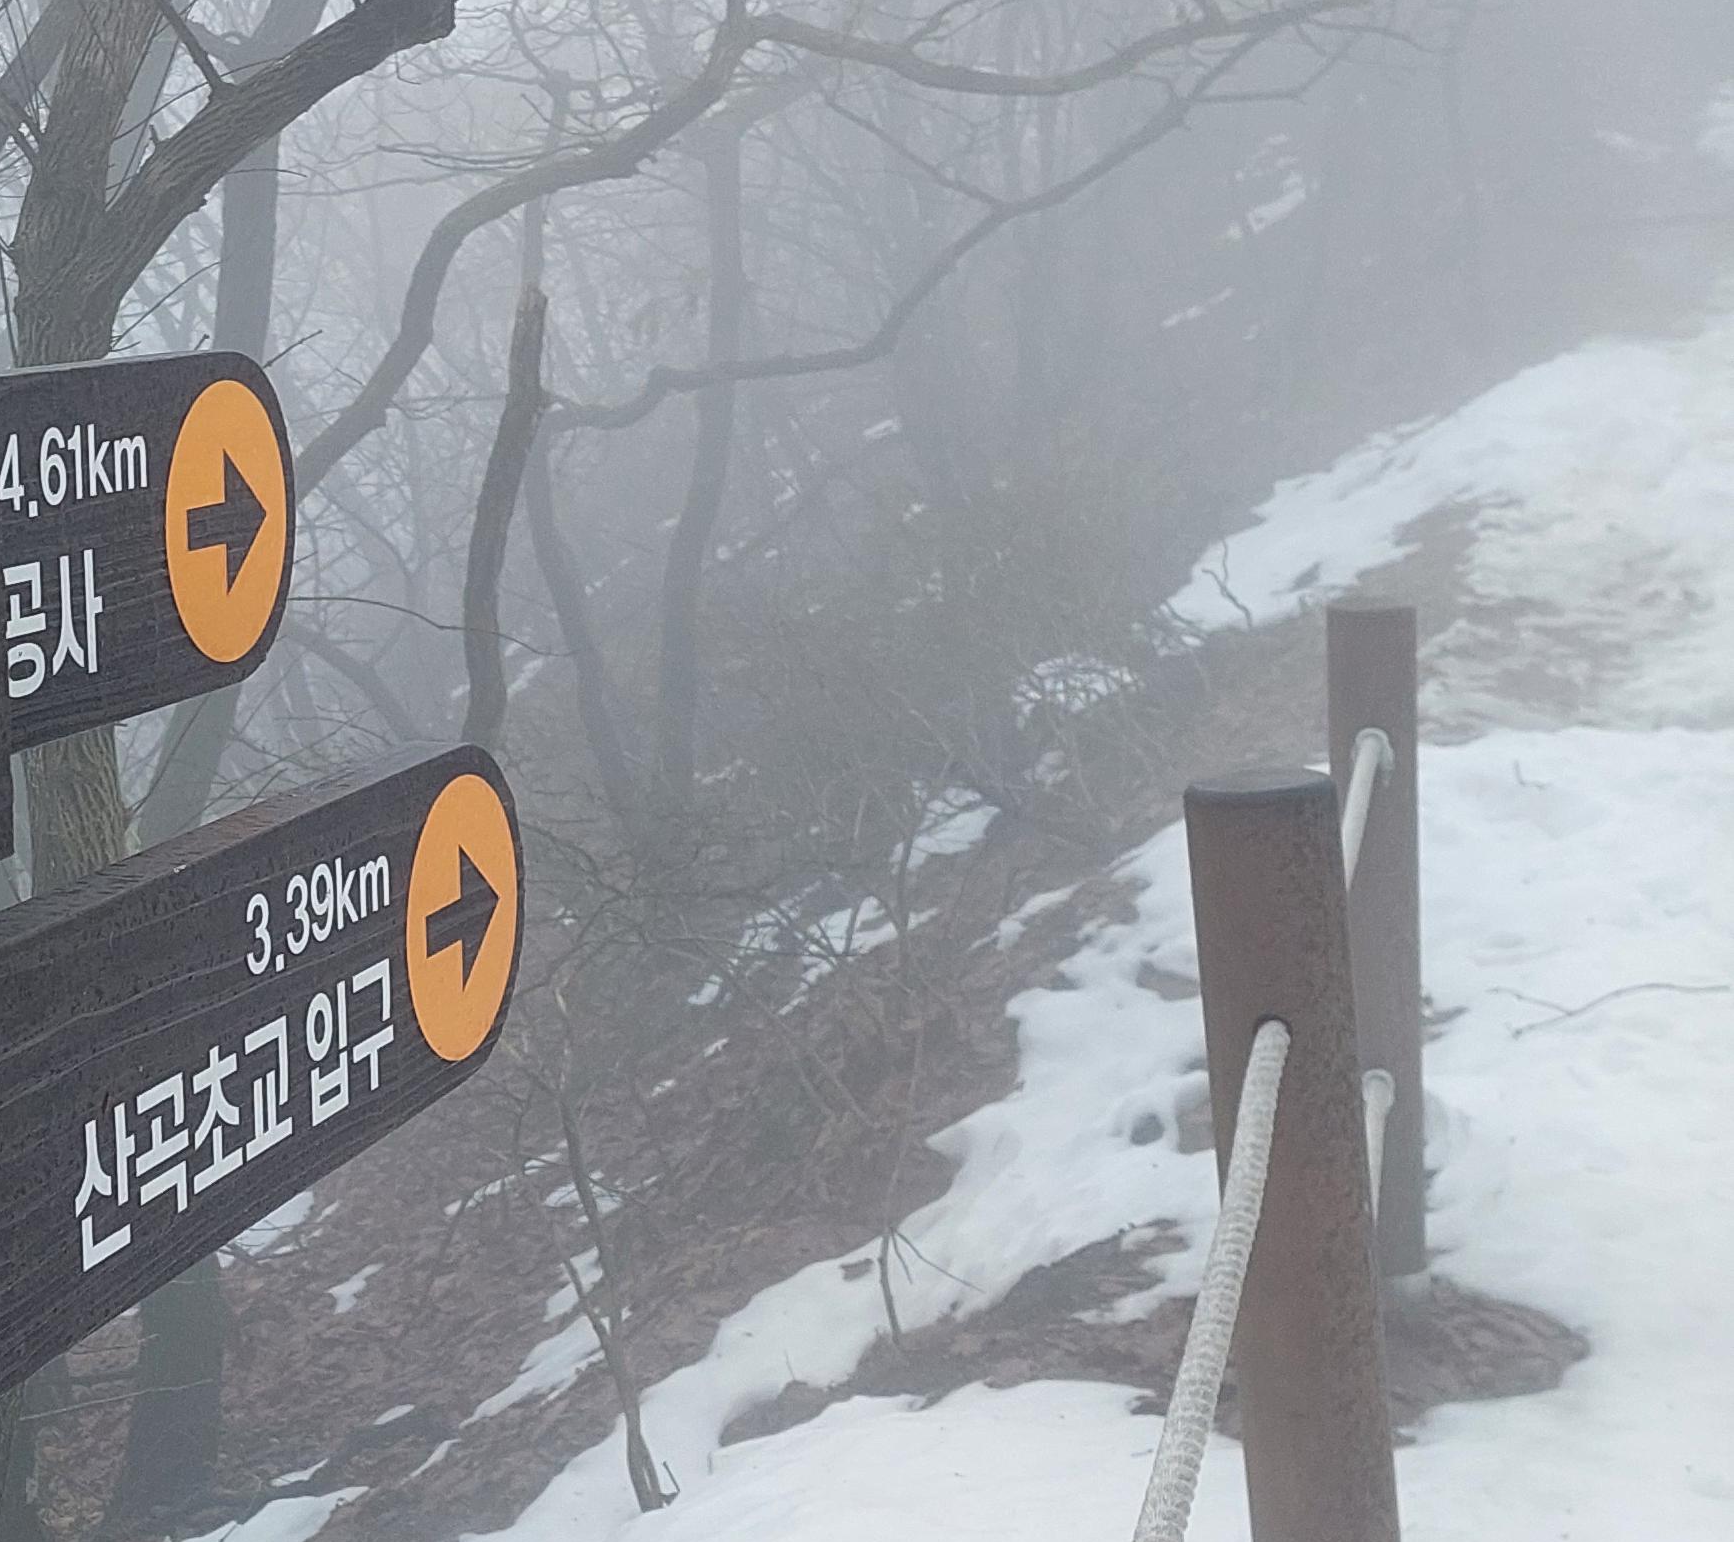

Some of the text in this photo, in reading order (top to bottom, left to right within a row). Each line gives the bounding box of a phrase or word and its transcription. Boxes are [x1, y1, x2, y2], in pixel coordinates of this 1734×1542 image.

[246, 855, 390, 975] 3.39km
[74, 957, 395, 1272] 산곡초교 입구
